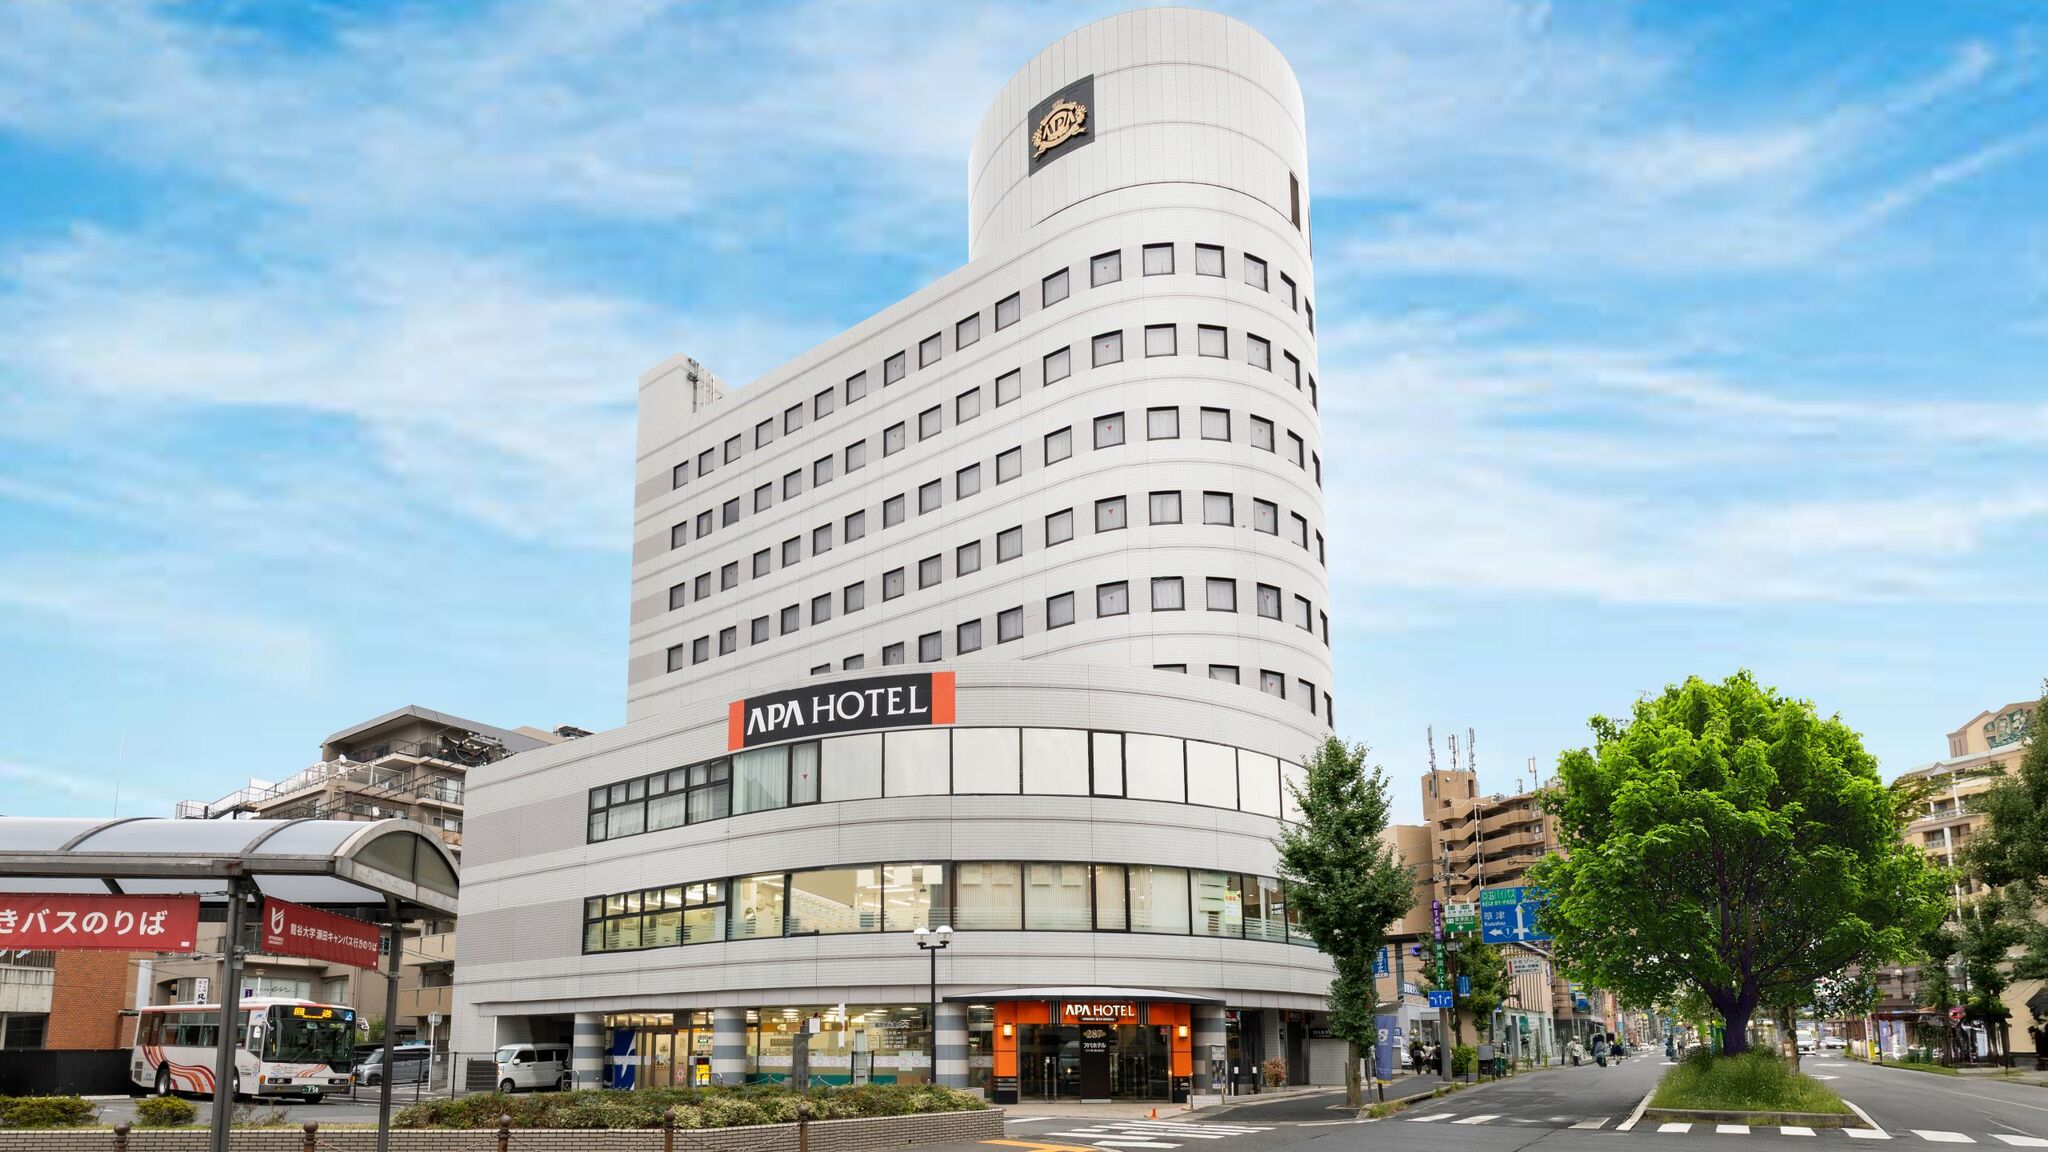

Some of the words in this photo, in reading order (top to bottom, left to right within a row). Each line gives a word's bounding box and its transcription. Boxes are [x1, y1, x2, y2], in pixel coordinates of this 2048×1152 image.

[1042, 111, 1076, 139] APA
[747, 700, 804, 736] APA
[812, 685, 928, 723] HOTEL
[1484, 911, 1505, 920] 草津
[1065, 1004, 1091, 1016] APA
[1093, 1004, 1135, 1017] HOTEL
[1086, 1029, 1103, 1039] 287
